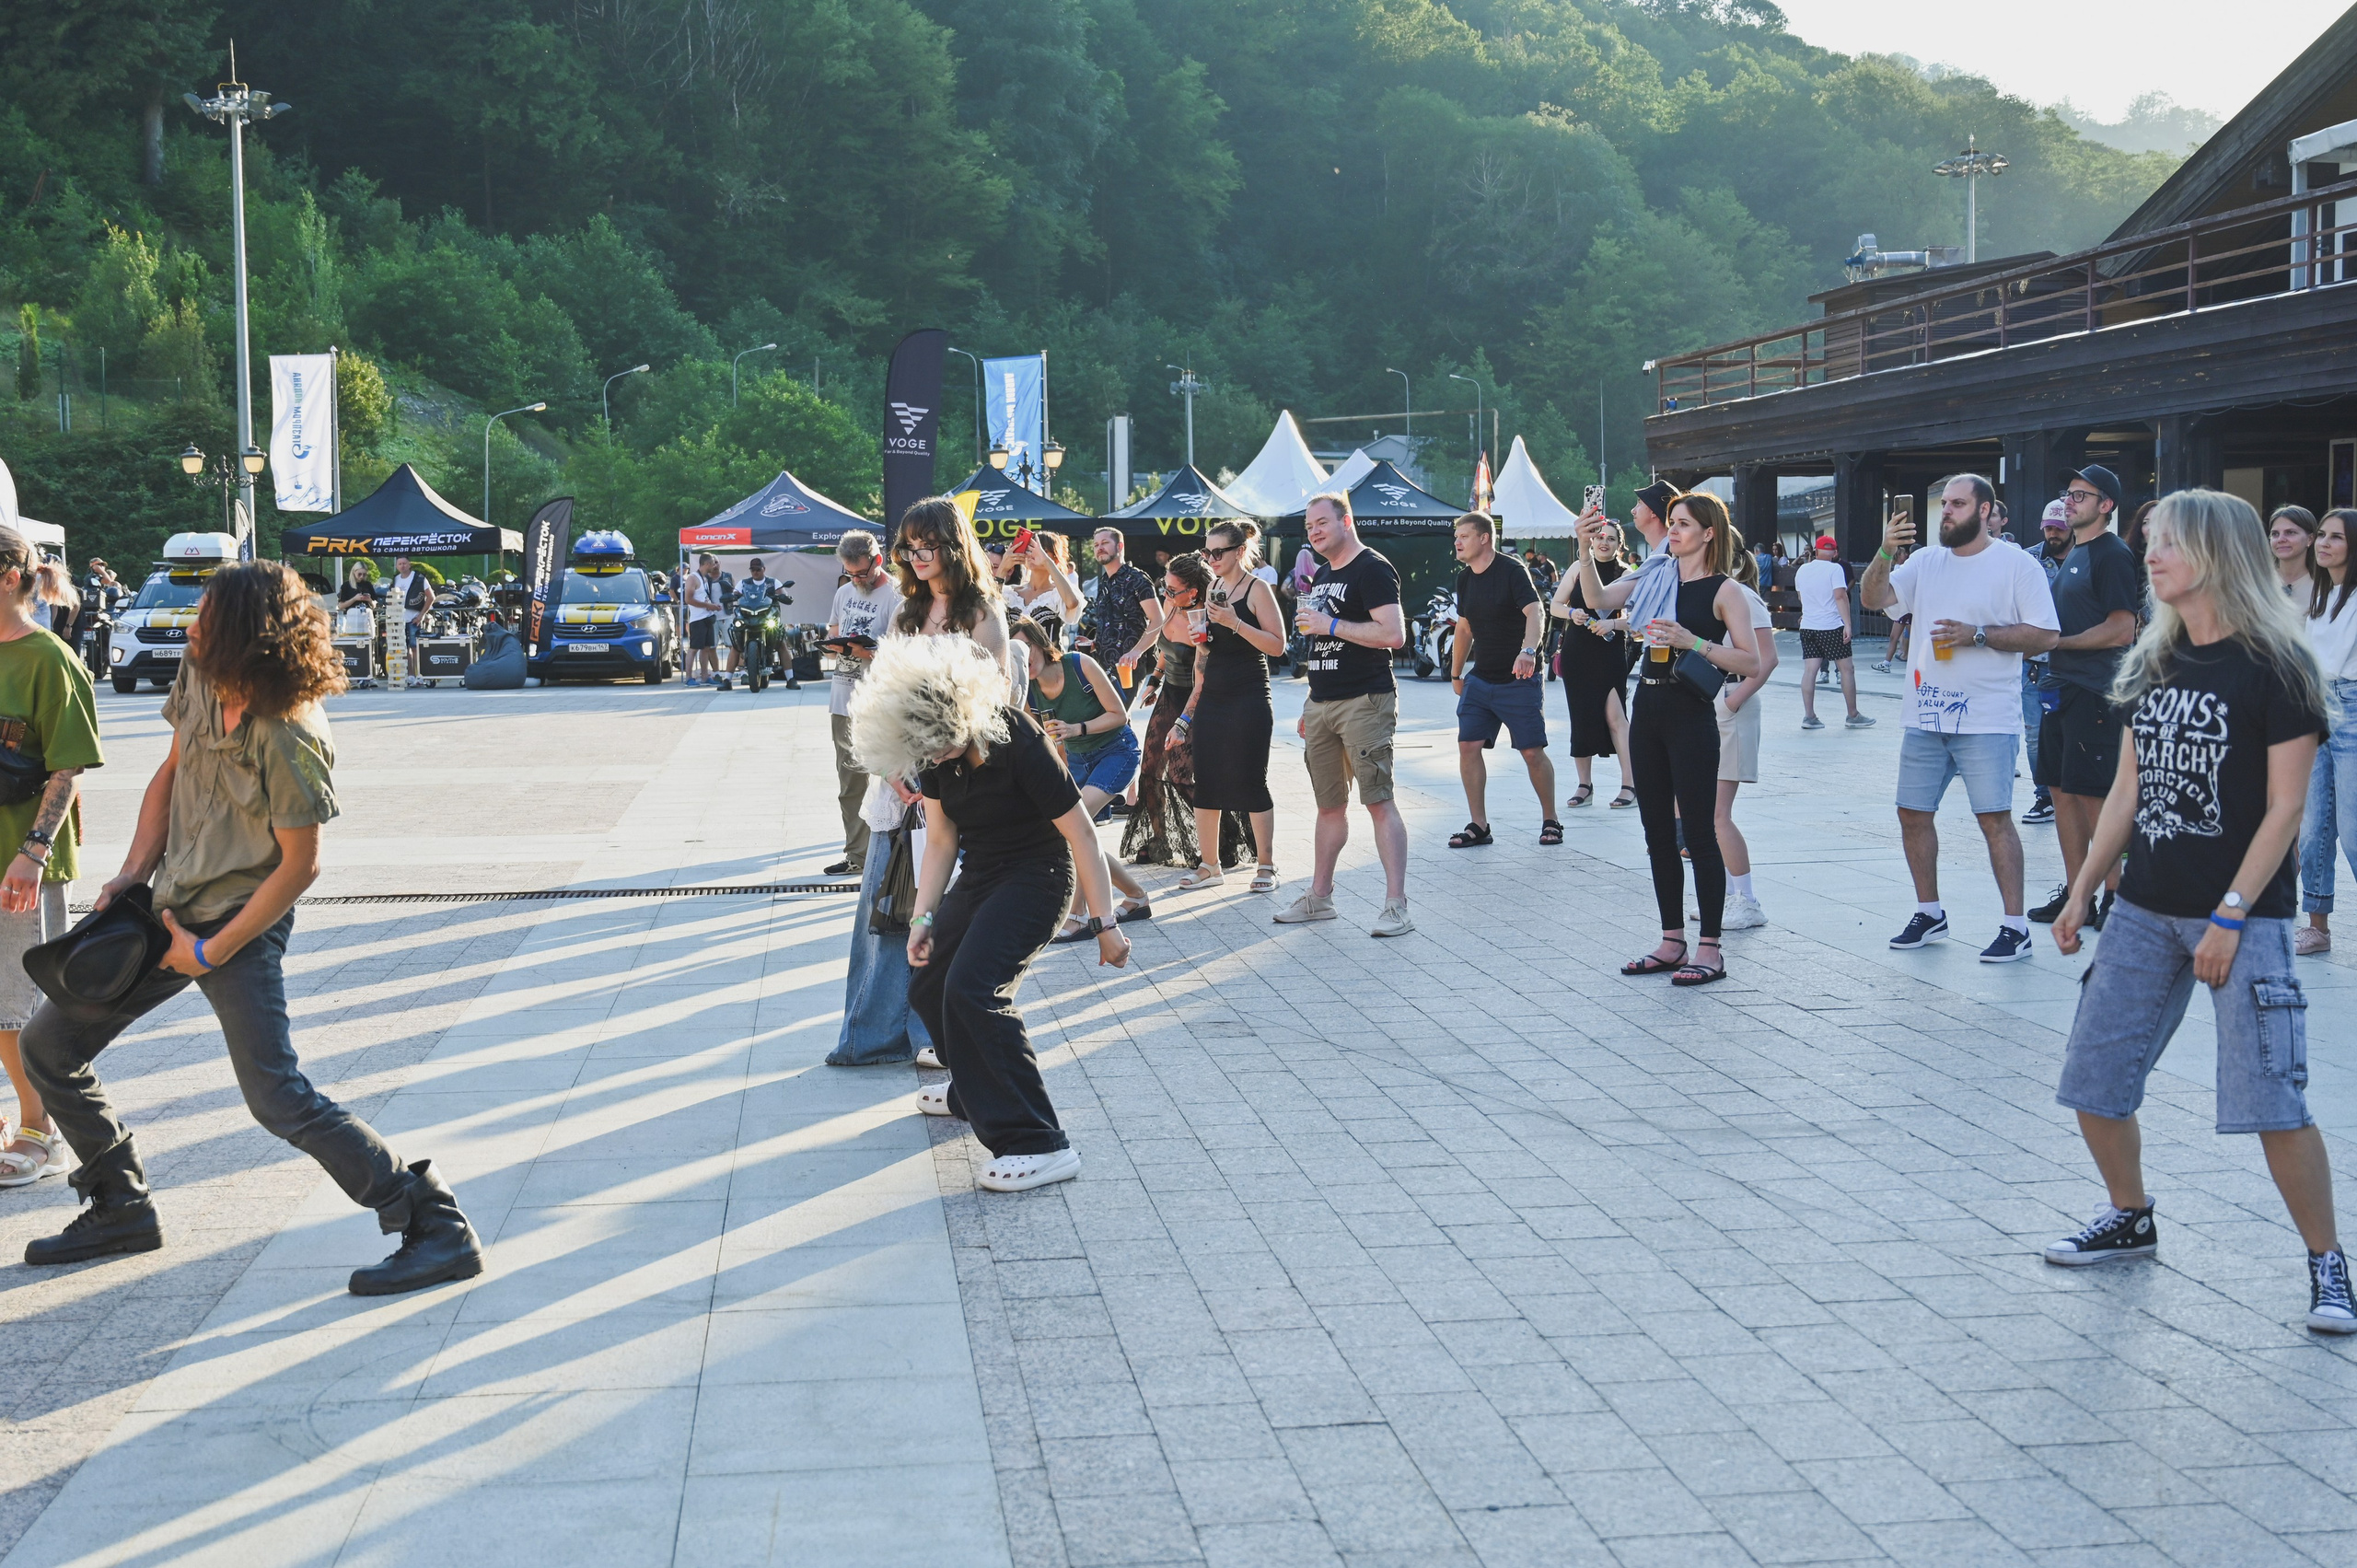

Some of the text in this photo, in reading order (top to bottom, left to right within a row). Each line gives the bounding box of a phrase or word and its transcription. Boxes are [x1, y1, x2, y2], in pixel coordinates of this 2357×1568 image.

[888, 437, 926, 449] VOGE
[976, 505, 1014, 513] VOGE
[973, 518, 1043, 538] OGE
[307, 536, 372, 552] PRK
[373, 532, 472, 546] ПЕРЕКРЁСТОК
[533, 519, 551, 600] ПЕРЕКРЁСТОК
[547, 533, 555, 571] автошкола
[1322, 658, 1339, 670] FIRE
[1942, 690, 1964, 698] COURT
[1918, 700, 1945, 708] D'AZUR
[2138, 687, 2217, 727] SONS
[2159, 724, 2178, 740] OF
[2134, 738, 2231, 774] NARCHY
[2138, 768, 2218, 817] TORCYCLE
[2142, 785, 2178, 806] CLUB
